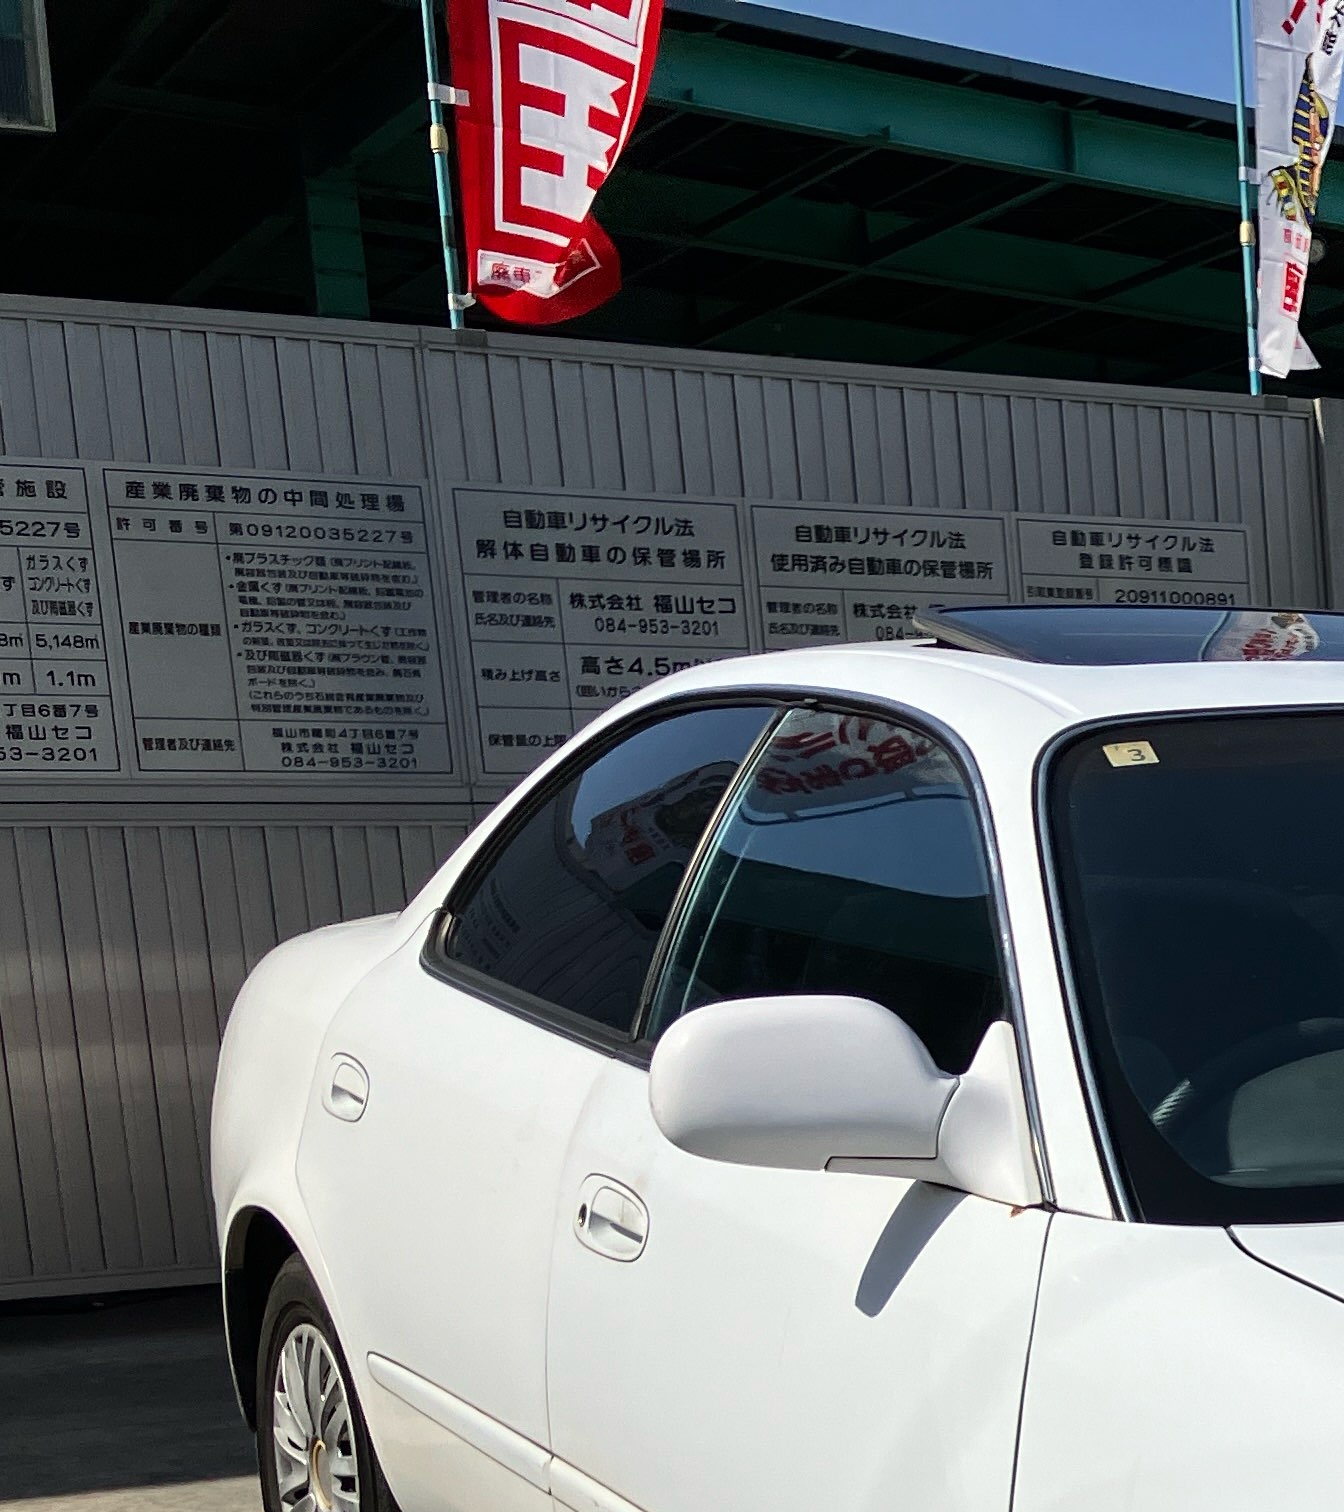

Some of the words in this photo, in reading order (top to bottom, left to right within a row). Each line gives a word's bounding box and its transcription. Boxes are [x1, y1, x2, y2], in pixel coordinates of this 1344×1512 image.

[0, 479, 68, 499] 施設
[125, 480, 406, 513] 産業廃棄物の中間処理場
[116, 517, 209, 534] 許可番号
[503, 509, 697, 539] 自動車リサイクル法
[795, 523, 968, 551] 自動車リサイクル法
[1051, 529, 1216, 554] 自動車リサイクル法
[475, 538, 728, 570] 解体自動車の保管場所
[770, 553, 994, 581] 使用済み自動車の保管場所
[569, 592, 644, 612] 株式会社
[653, 594, 738, 616] 福山セコ
[1115, 588, 1236, 606] 20911000891
[594, 617, 720, 638] 084-953-3201
[46, 670, 97, 687] 1.1m
[5, 724, 92, 741] 福山セコ
[281, 756, 419, 770] 084-953-3201
[1127, 748, 1146, 762] 3
